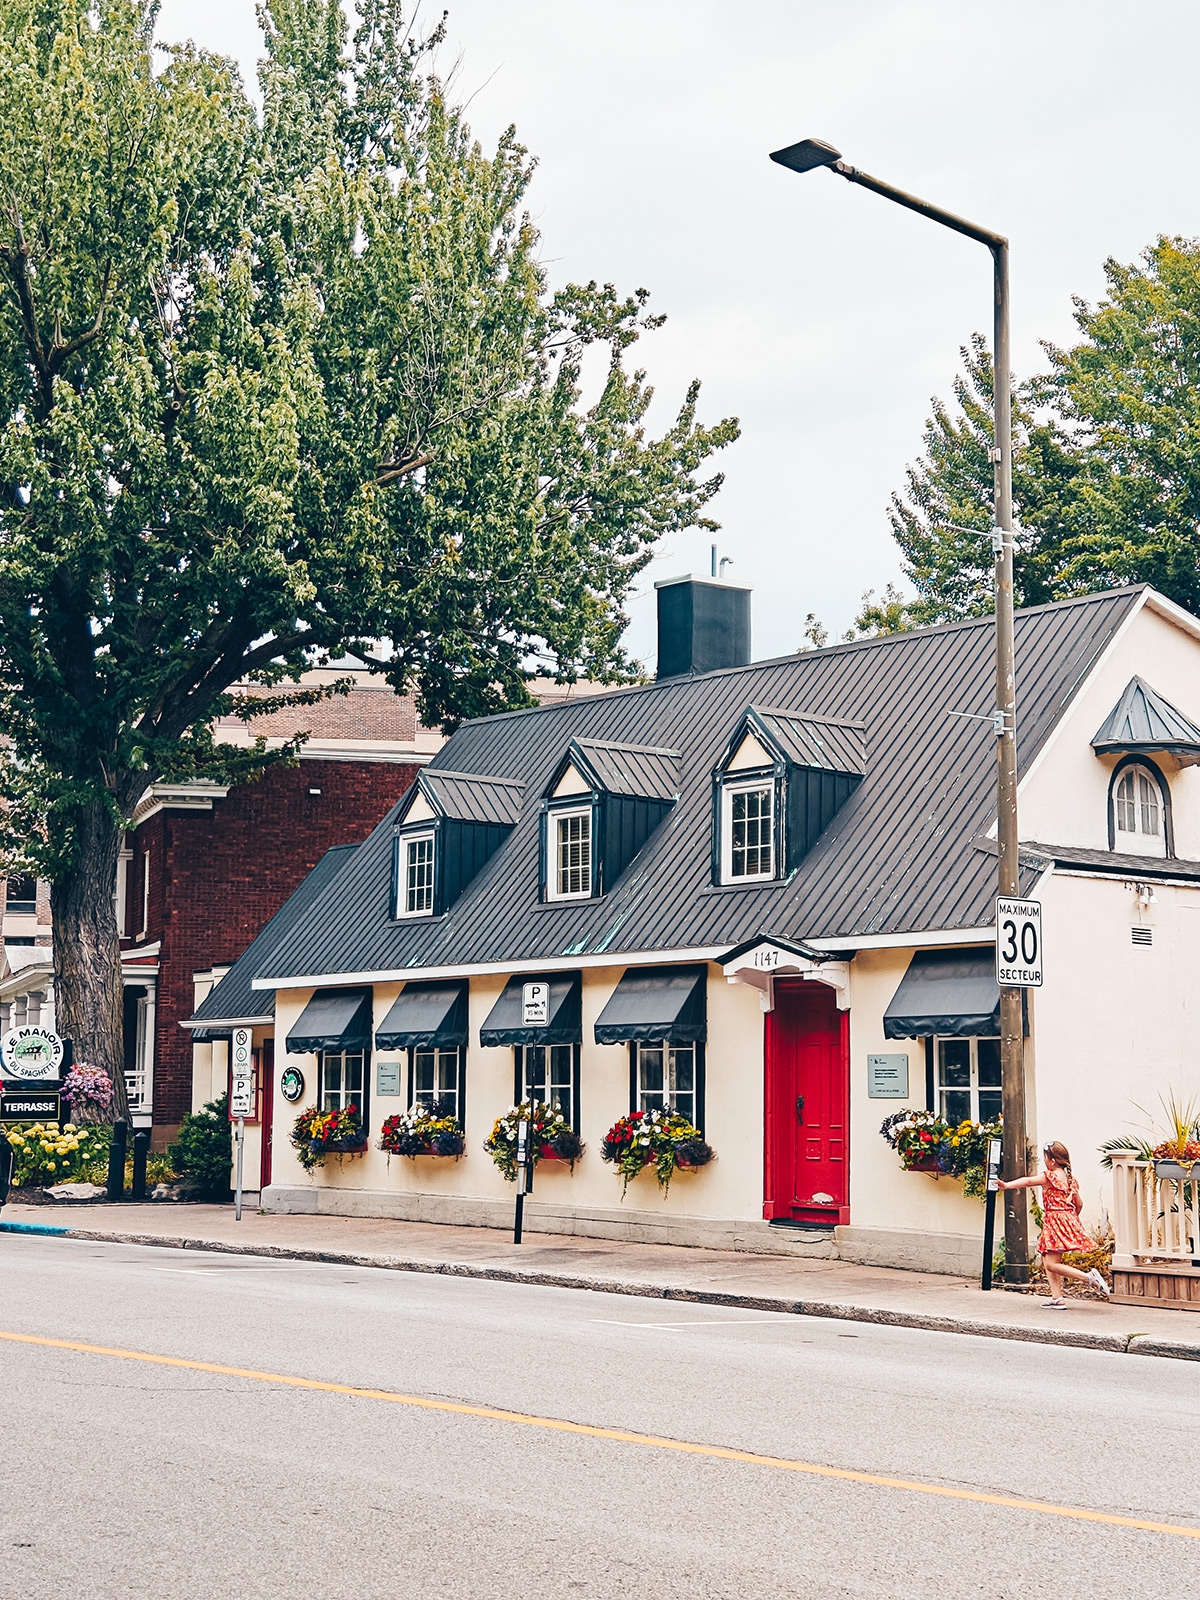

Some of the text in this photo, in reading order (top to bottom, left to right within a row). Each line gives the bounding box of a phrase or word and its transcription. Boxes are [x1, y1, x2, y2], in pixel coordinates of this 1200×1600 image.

[999, 904, 1039, 917] MAXIMUM
[1002, 920, 1037, 965] 30
[754, 951, 778, 966] 1147
[1000, 968, 1041, 981] SECTEUR
[532, 986, 540, 999] P
[7, 1028, 60, 1055] LE MANOIR
[9, 1061, 57, 1077] DU SPAGHETTI
[237, 1081, 245, 1092] P
[4, 1102, 56, 1112] TERRASSE
